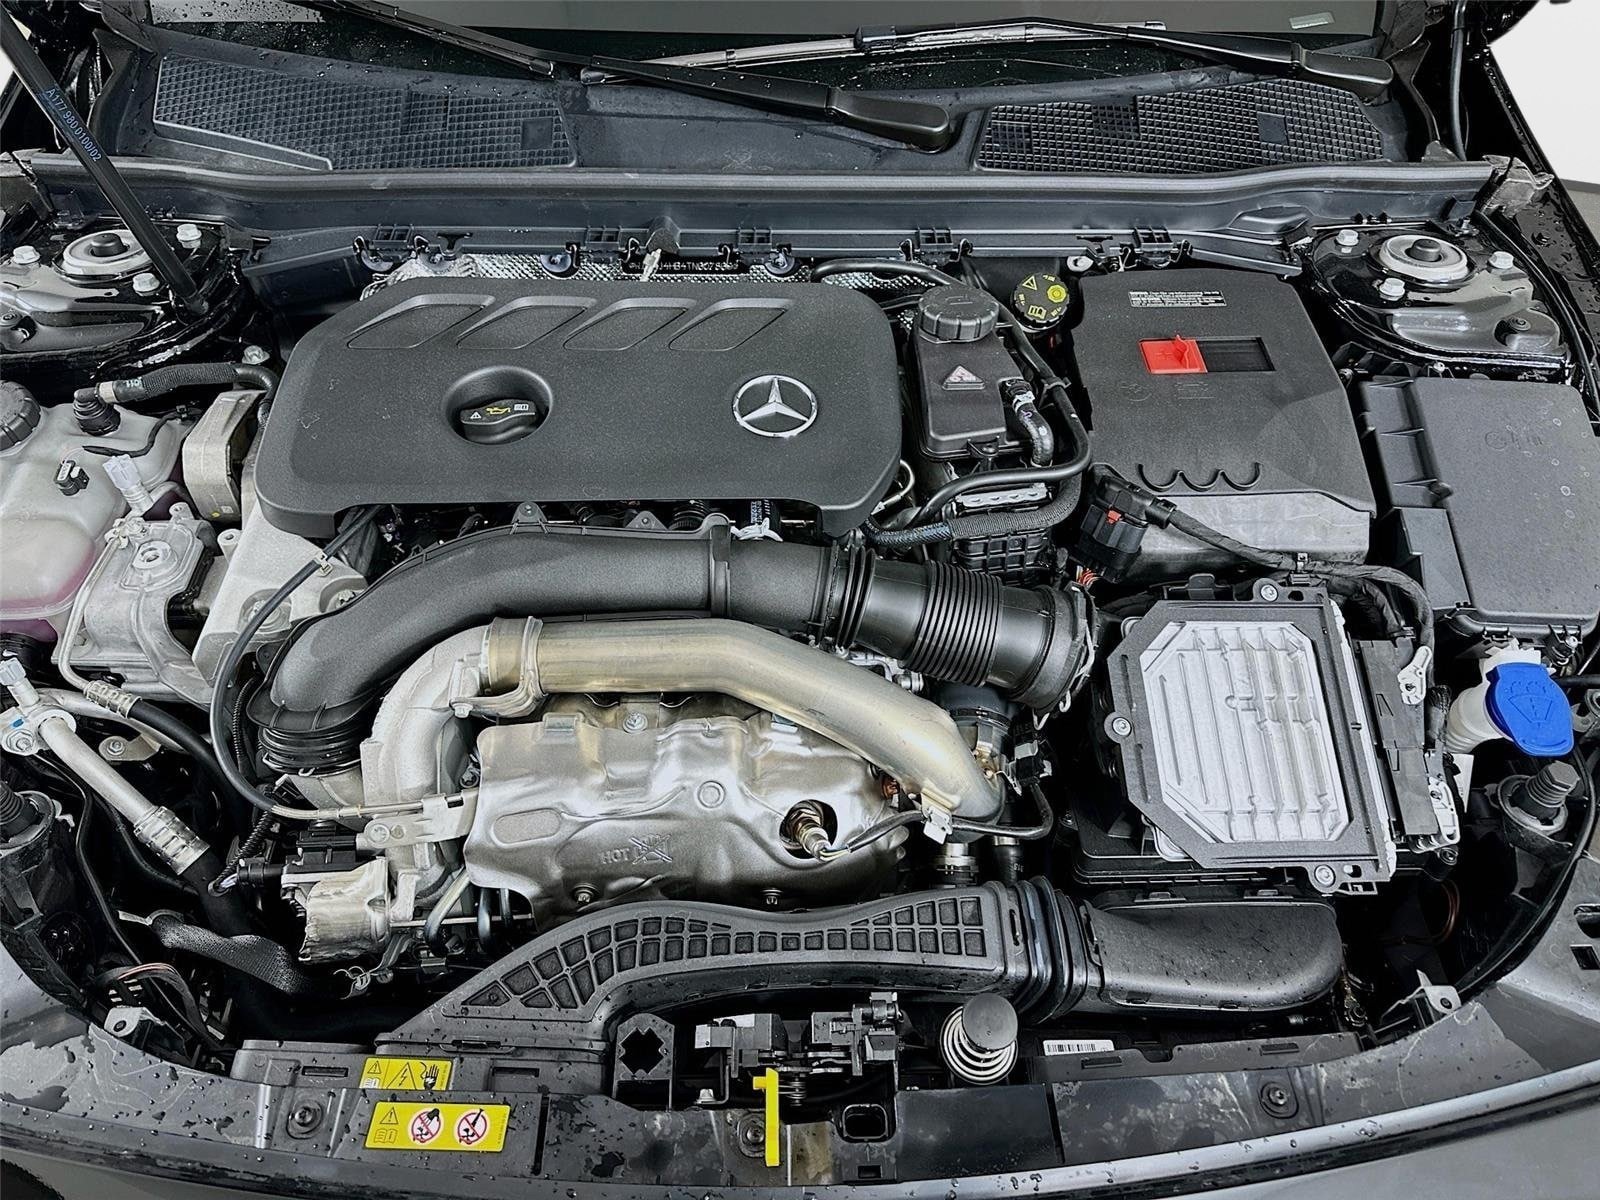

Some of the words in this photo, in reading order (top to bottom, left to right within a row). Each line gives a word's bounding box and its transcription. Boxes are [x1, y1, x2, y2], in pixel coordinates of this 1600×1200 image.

[47, 88, 67, 111] A177
[63, 111, 79, 128] 980
[75, 127, 102, 161] 0100/02
[598, 847, 630, 864] HOT
